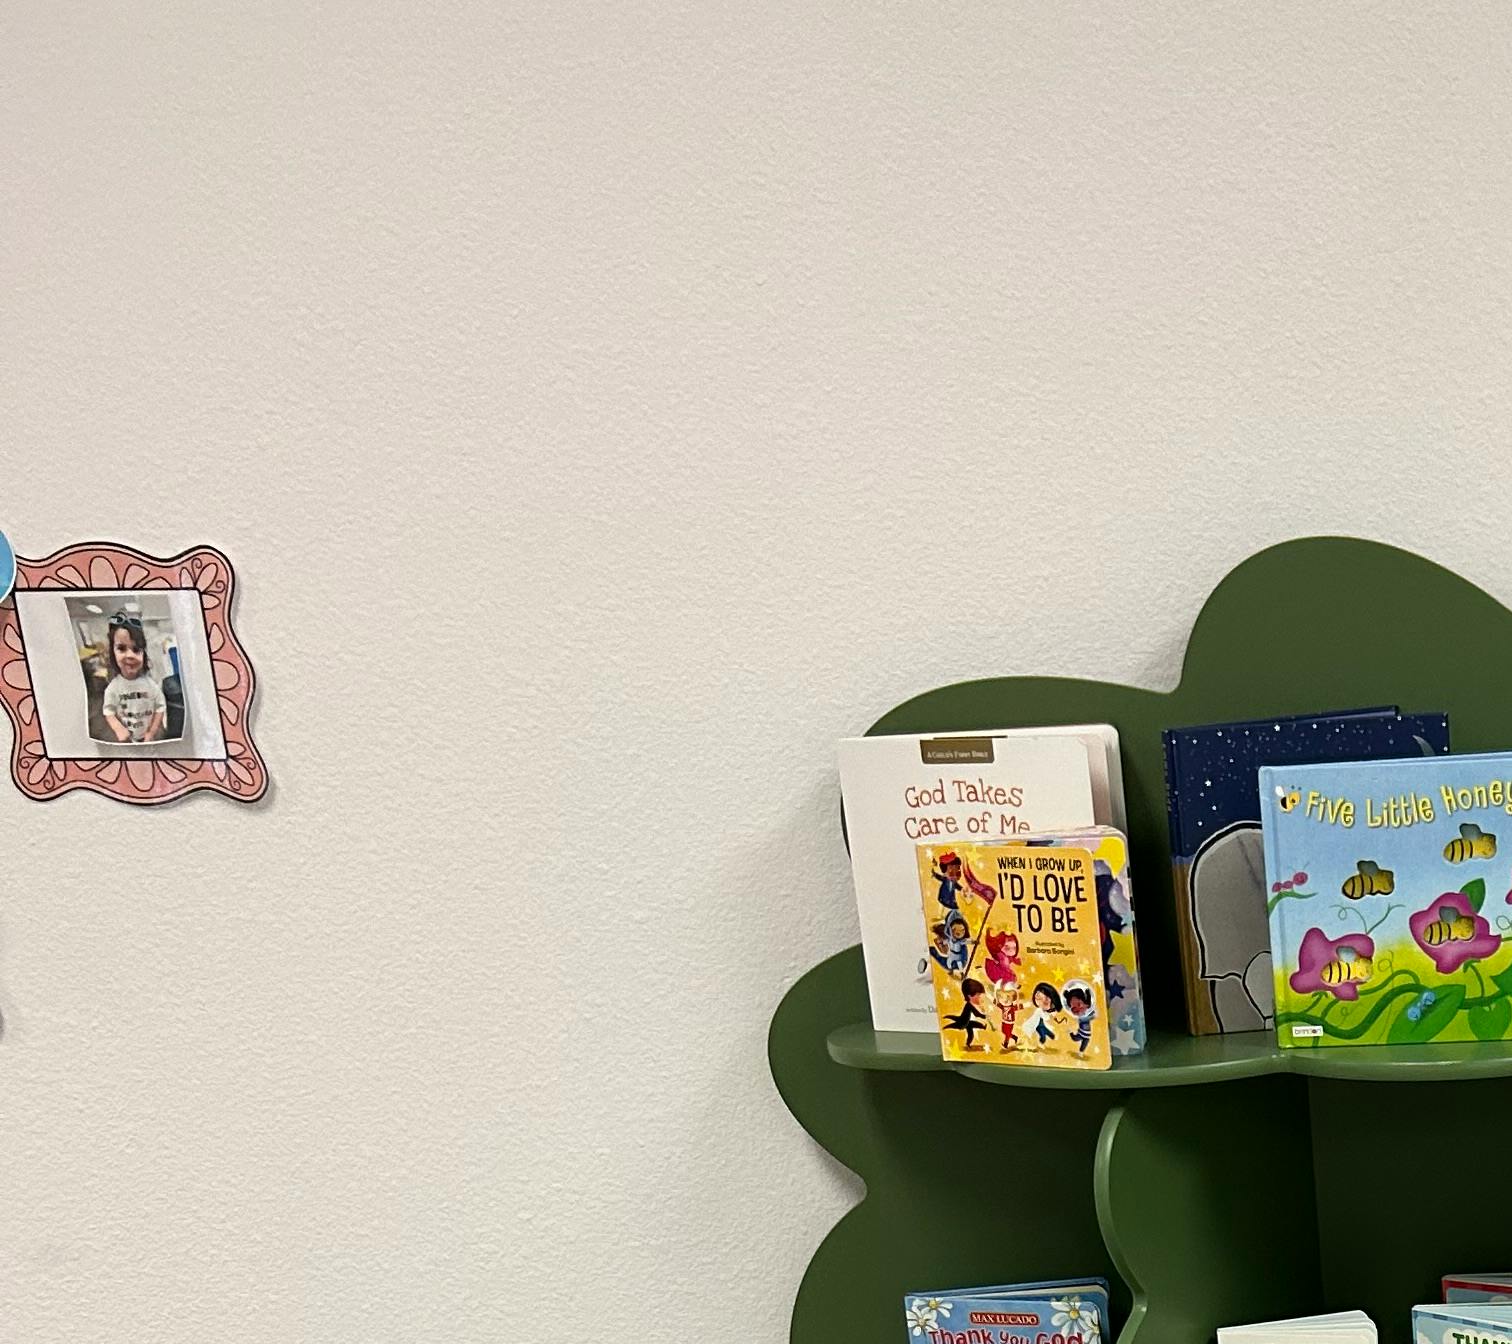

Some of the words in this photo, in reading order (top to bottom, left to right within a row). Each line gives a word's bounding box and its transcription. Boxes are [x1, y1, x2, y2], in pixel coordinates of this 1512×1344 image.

[905, 778, 946, 808] God
[952, 778, 1023, 808] Takes
[1305, 790, 1354, 827] Five
[1365, 791, 1435, 828] Little
[904, 816, 959, 839] Care
[967, 811, 992, 833] of
[1000, 814, 1030, 835] Me
[997, 857, 1026, 870] WHEN
[1029, 858, 1032, 869] I
[1035, 858, 1065, 871] GROW
[1069, 858, 1083, 874] UP,
[998, 872, 1024, 901] I'D
[1033, 874, 1087, 904] LOVE
[1012, 904, 1042, 933] TO
[1051, 906, 1078, 933] BE
[972, 1313, 995, 1322] MAX
[998, 1314, 1038, 1325] LUCADO
